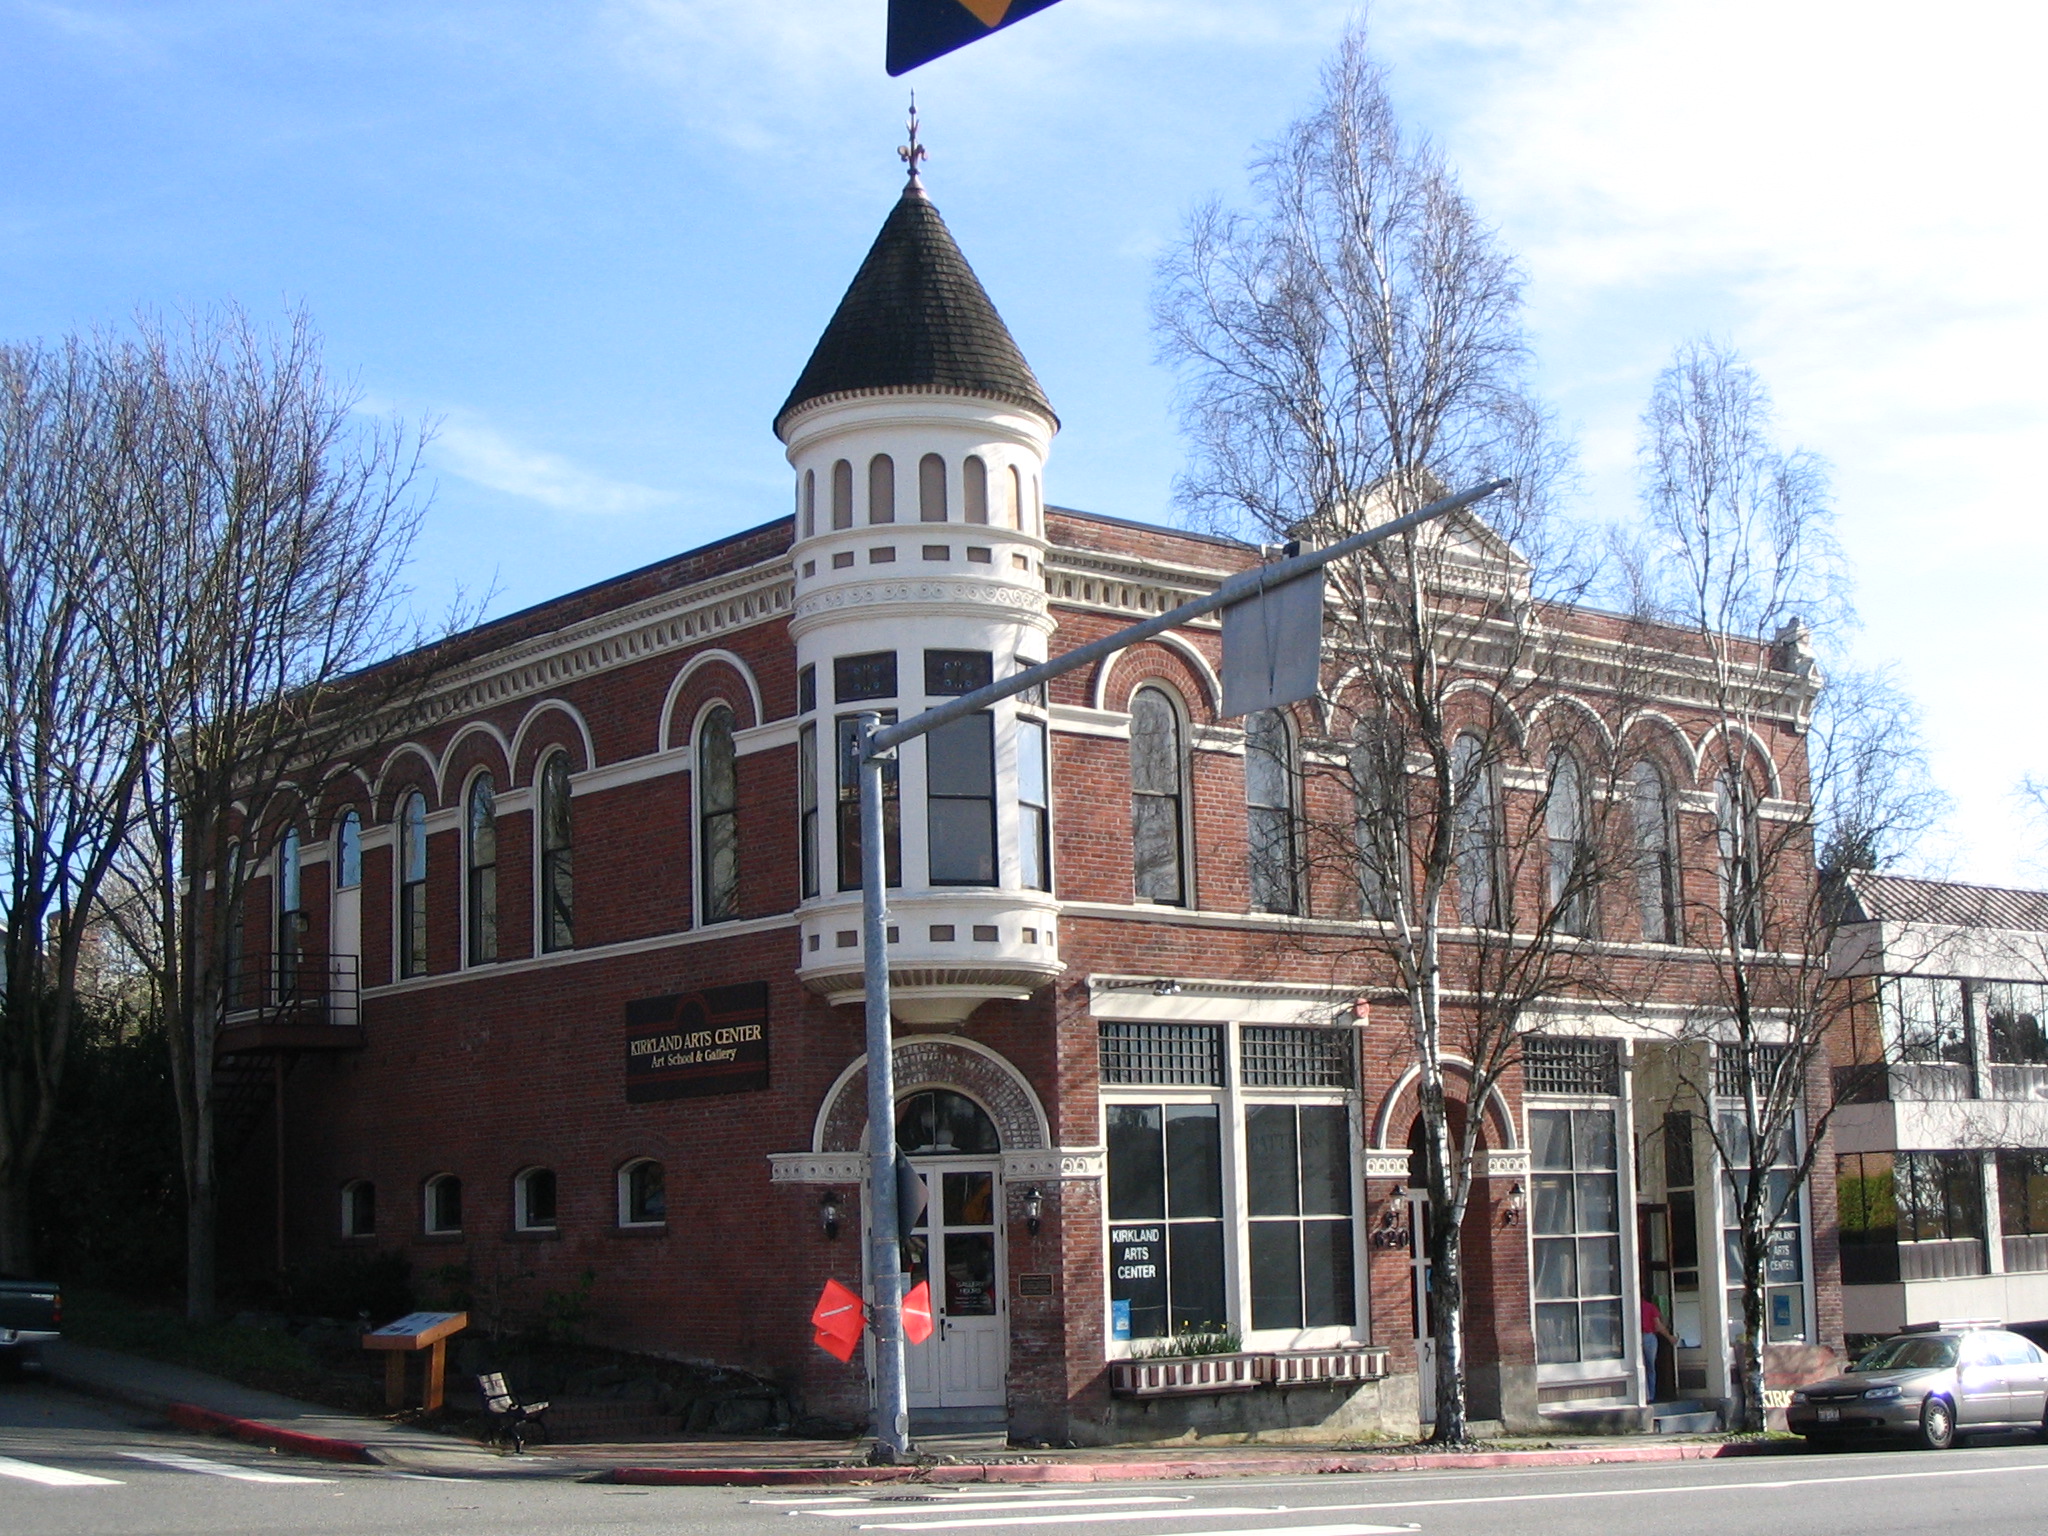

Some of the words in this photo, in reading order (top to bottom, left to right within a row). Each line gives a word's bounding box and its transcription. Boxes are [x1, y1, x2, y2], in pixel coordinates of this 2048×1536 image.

[630, 1035, 683, 1056] KIRKLAND
[684, 1031, 712, 1049] ARTS
[715, 1024, 762, 1045] CENTER
[651, 1055, 665, 1068] Art
[668, 1051, 694, 1067] School
[695, 1051, 703, 1062] &
[704, 1048, 738, 1061] Gallery
[1112, 1229, 1160, 1243] KIRKLAND
[1124, 1246, 1149, 1260] ARTS
[1773, 1245, 1790, 1255] ARTS
[1117, 1265, 1156, 1279] CENTER
[1770, 1260, 1794, 1270] CENTER
